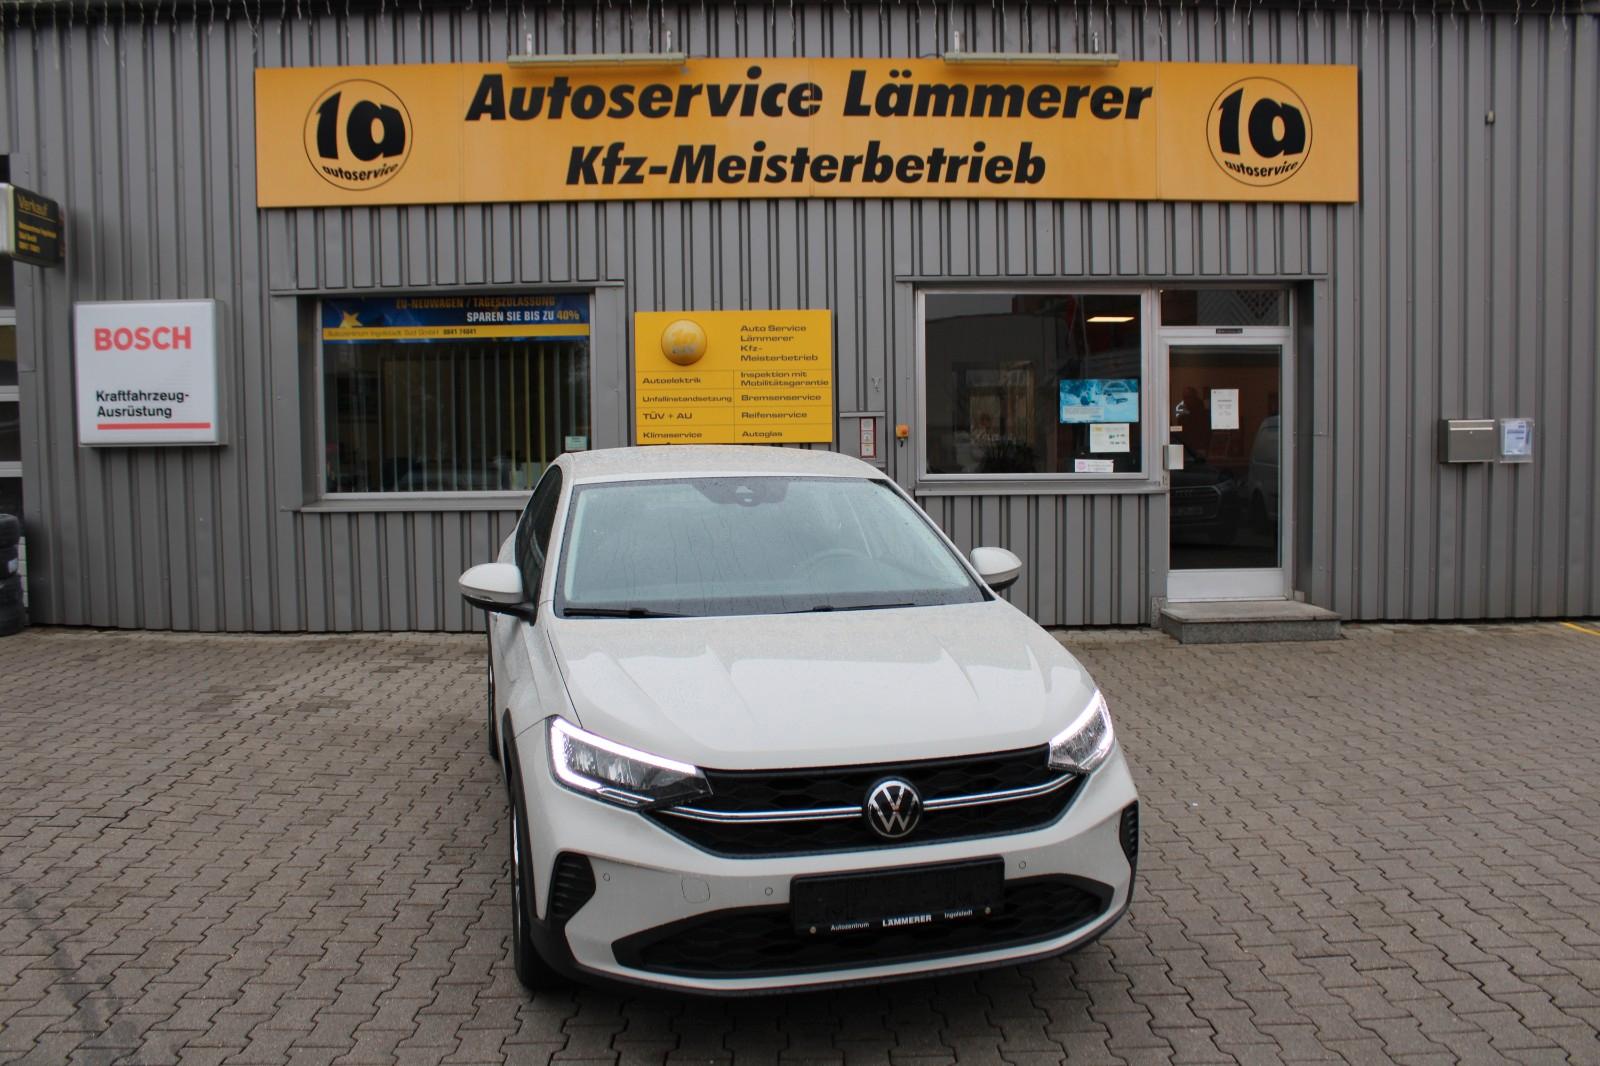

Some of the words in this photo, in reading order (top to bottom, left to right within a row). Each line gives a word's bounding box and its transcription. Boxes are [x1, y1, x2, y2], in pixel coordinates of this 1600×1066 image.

[465, 66, 822, 121] Autoservice
[843, 69, 1153, 120] Lämmerer
[316, 91, 406, 161] 1a
[1218, 87, 1306, 159] 1a
[566, 140, 1046, 185] Kfz-Meisterbetrieb
[1225, 159, 1299, 177] autoservice
[322, 163, 399, 182] autoservice
[466, 311, 504, 323] SPAREN
[506, 311, 522, 322] SIE
[524, 311, 541, 322] BIS
[543, 310, 555, 321] ZU
[556, 310, 580, 321] 40%
[740, 324, 766, 332] Auto
[768, 324, 806, 332] Service
[94, 326, 192, 352] BOSCH
[740, 334, 794, 342] Lämmerer
[740, 354, 818, 362] Meisterbetrieb
[642, 377, 701, 385] Autoelektrik
[741, 371, 790, 379] Inspektion
[741, 379, 829, 387] Mobilitätsgarantie
[96, 390, 189, 403] Kraftfahrzeug-
[97, 405, 173, 419] Ausrüstung
[643, 411, 665, 420] TÜV
[676, 412, 693, 420] AU
[741, 411, 808, 419] Reifenservice
[830, 922, 870, 932] Autozentrum
[882, 914, 932, 928] LÄMMERER
[944, 909, 973, 919] Ingolstadt
